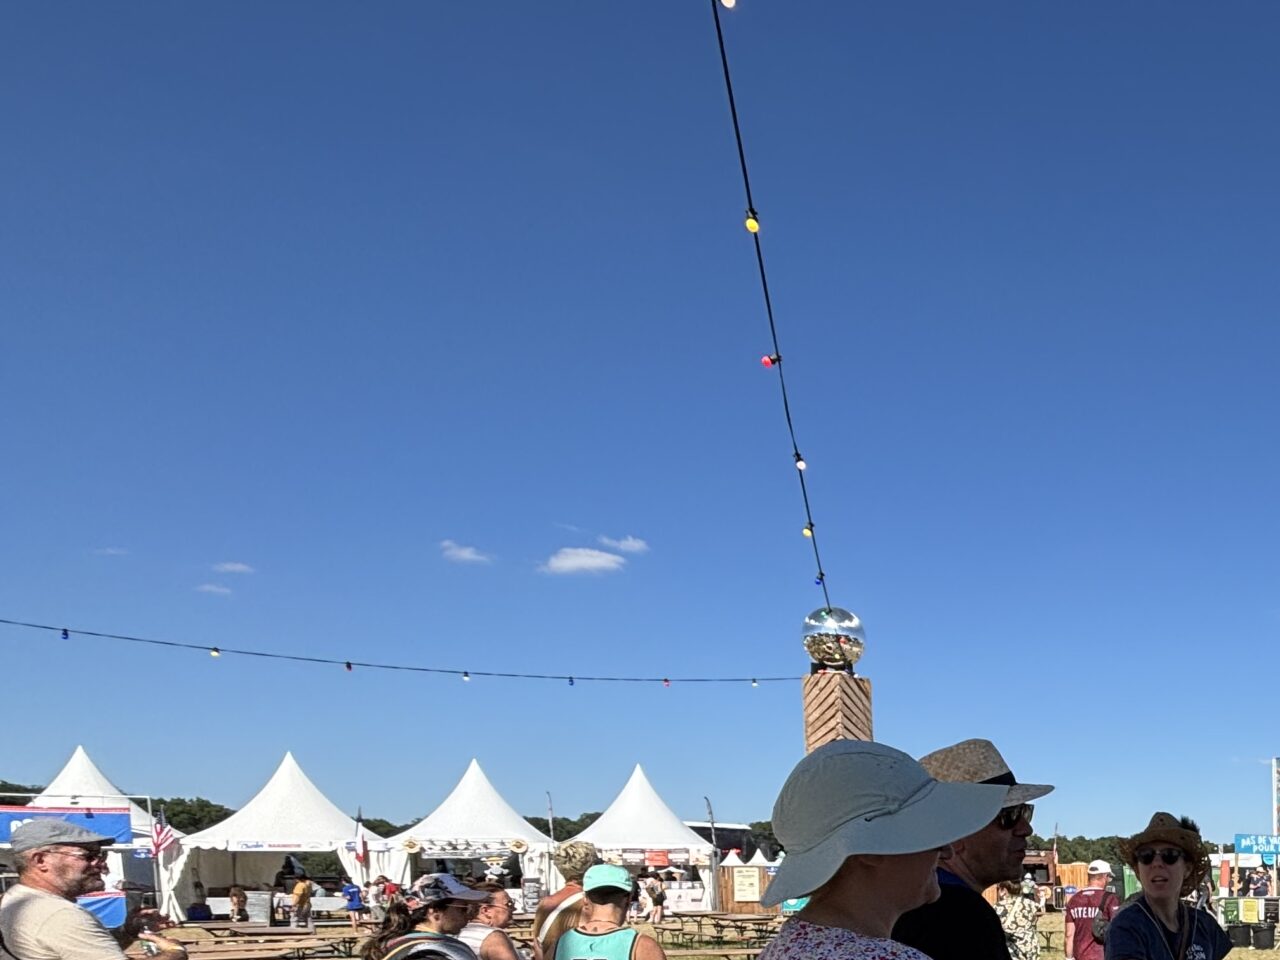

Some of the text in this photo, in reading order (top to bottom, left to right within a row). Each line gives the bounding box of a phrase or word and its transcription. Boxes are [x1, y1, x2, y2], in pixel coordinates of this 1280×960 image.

[1241, 836, 1256, 848] PAS
[1258, 835, 1267, 844] DE
[1252, 844, 1276, 854] POUR
